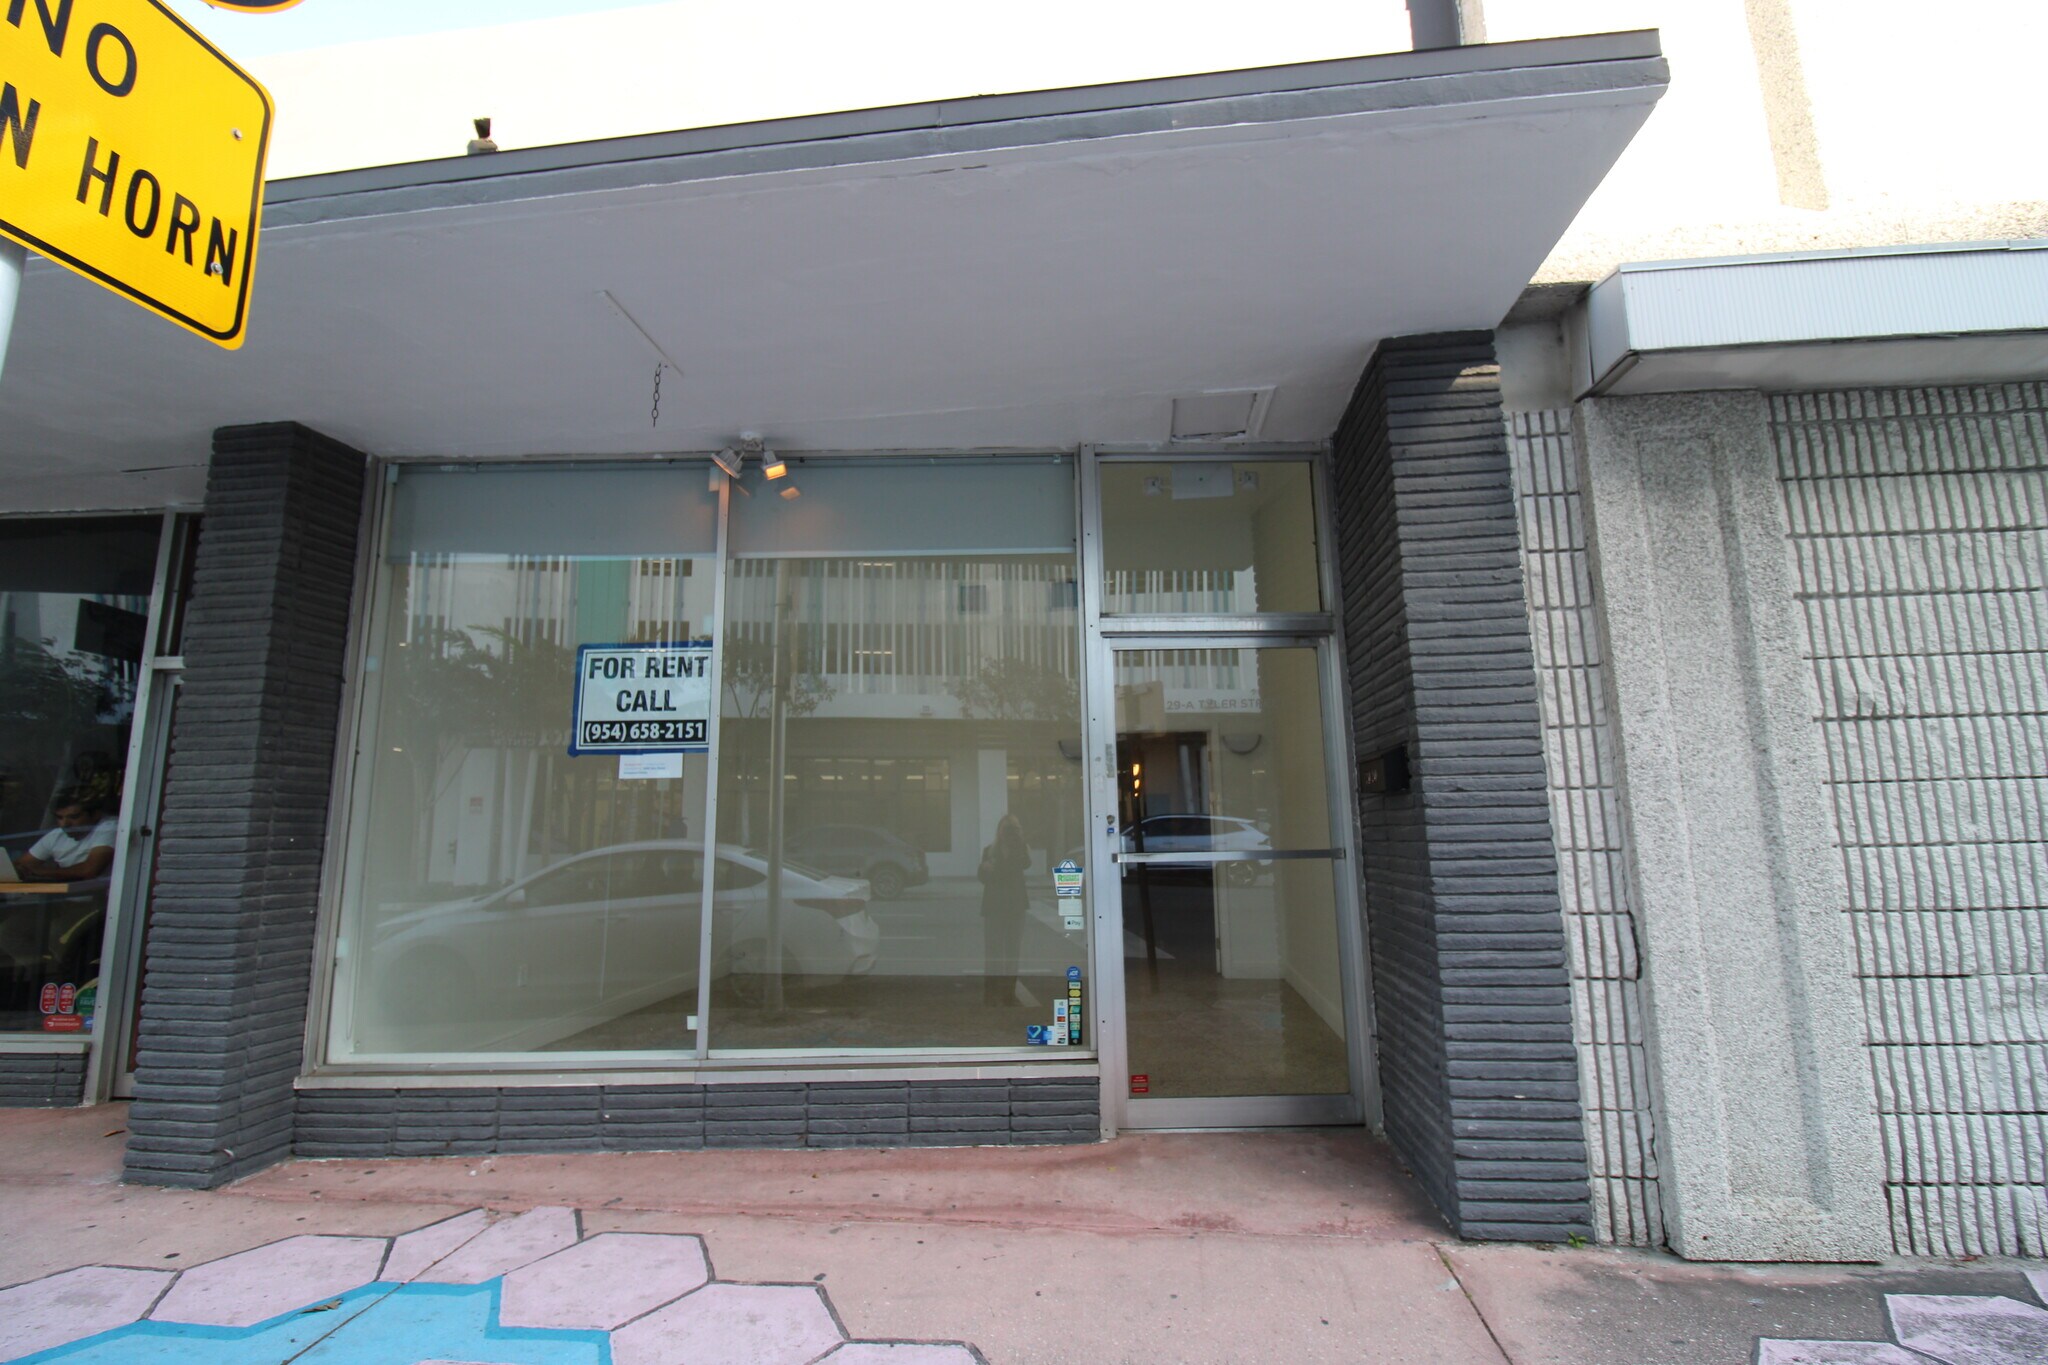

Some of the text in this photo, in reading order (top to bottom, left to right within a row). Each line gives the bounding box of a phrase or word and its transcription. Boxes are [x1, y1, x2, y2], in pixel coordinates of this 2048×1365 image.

[6, 0, 137, 98] NO
[76, 136, 238, 288] HORN
[589, 656, 709, 679] FOR RENT
[616, 690, 677, 713] CALL
[585, 722, 627, 743] (954)
[630, 722, 703, 740] 658-2151
